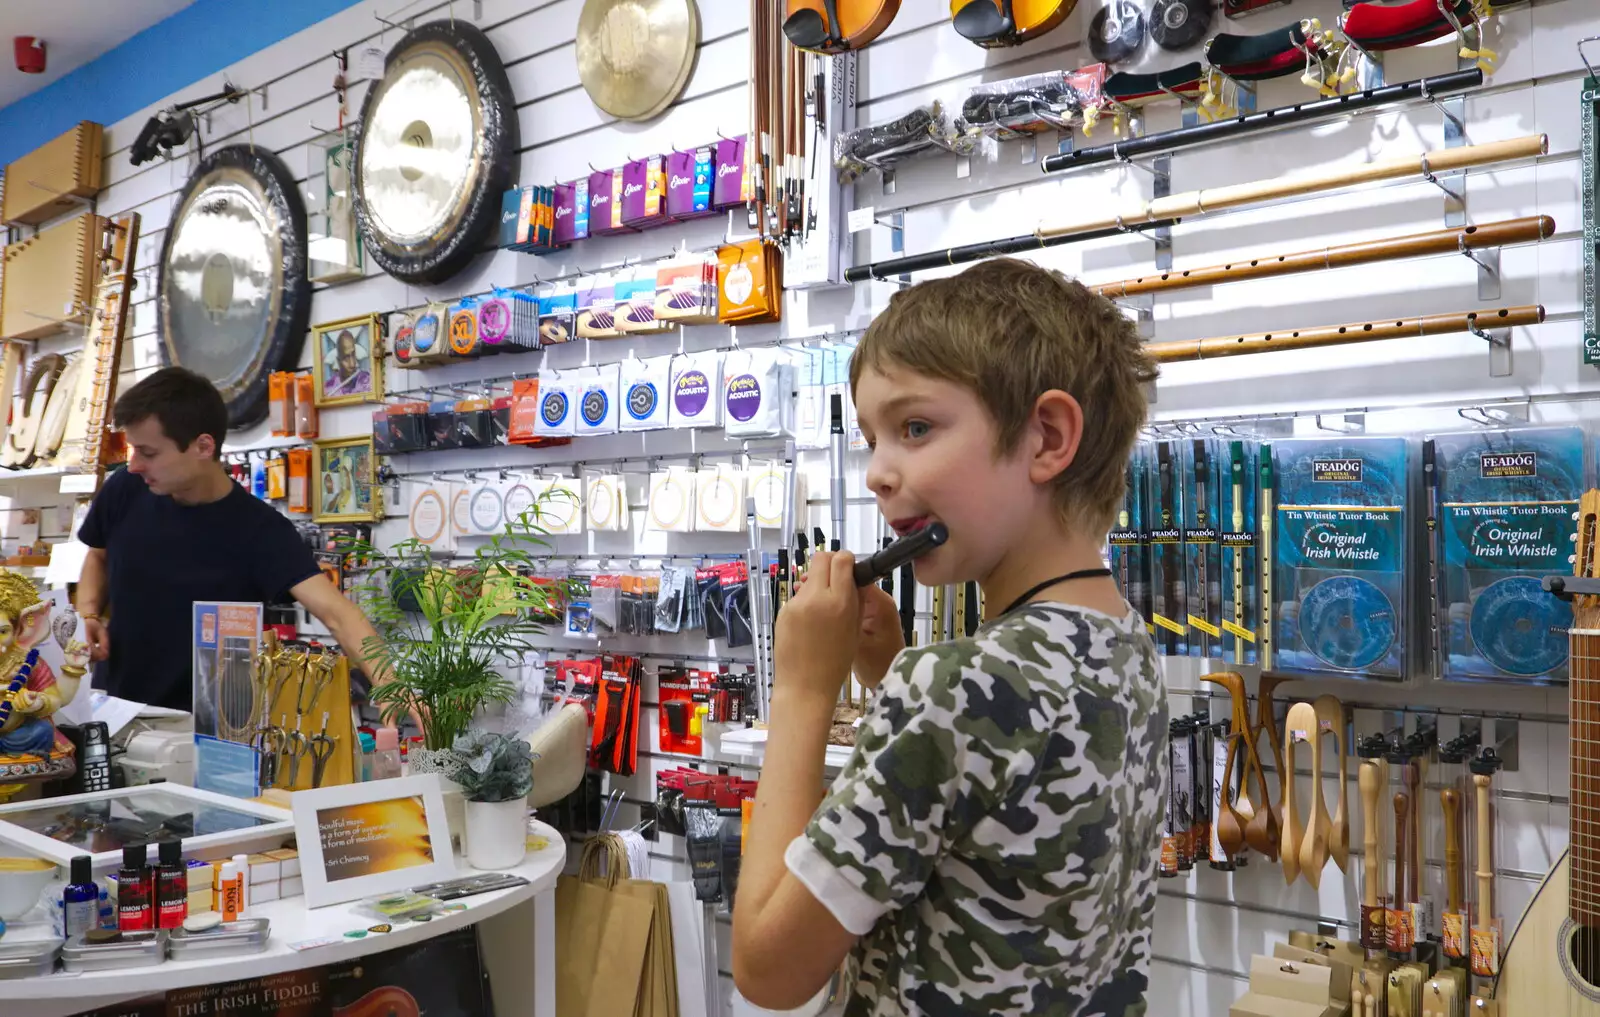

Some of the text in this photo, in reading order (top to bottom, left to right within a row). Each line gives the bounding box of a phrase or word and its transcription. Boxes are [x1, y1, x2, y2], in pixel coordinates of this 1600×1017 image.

[719, 163, 739, 177] Elixir
[670, 175, 691, 189] Elixir
[624, 183, 643, 196] Elixir
[592, 193, 609, 207] Elixir
[556, 206, 572, 219] Elixir
[677, 386, 707, 396] ACOUSTIC
[728, 389, 759, 400] ACOUSTIC
[1315, 460, 1360, 472] FEADÓG
[1483, 455, 1533, 467] FEADÓG
[1287, 511, 1389, 520] Tin Whistle Tutor Book
[1453, 506, 1567, 516] Tin Whistle Tutor Book
[1110, 530, 1137, 539] FEADÓG
[1152, 528, 1179, 537] FEADÓG
[1187, 528, 1215, 537] FEADÓG
[1223, 532, 1251, 540] FEADÓG
[1489, 528, 1542, 544] Original
[1318, 532, 1366, 548] Original
[1306, 547, 1379, 560] Irish Whistle
[1475, 544, 1557, 556] Irish Whistle
[319, 817, 345, 830] Soulful
[334, 829, 352, 838] form
[352, 825, 360, 835] of
[327, 839, 345, 848] form
[346, 837, 355, 845] of
[339, 854, 370, 865] Chinmoy
[161, 898, 183, 906] LEMON
[179, 987, 220, 1001] complete
[222, 982, 246, 995] guide
[248, 981, 259, 990] to
[260, 974, 296, 988] learning
[175, 1000, 208, 1017] THE
[214, 992, 257, 1011] IRISH
[264, 982, 321, 1002] FIDDLE
